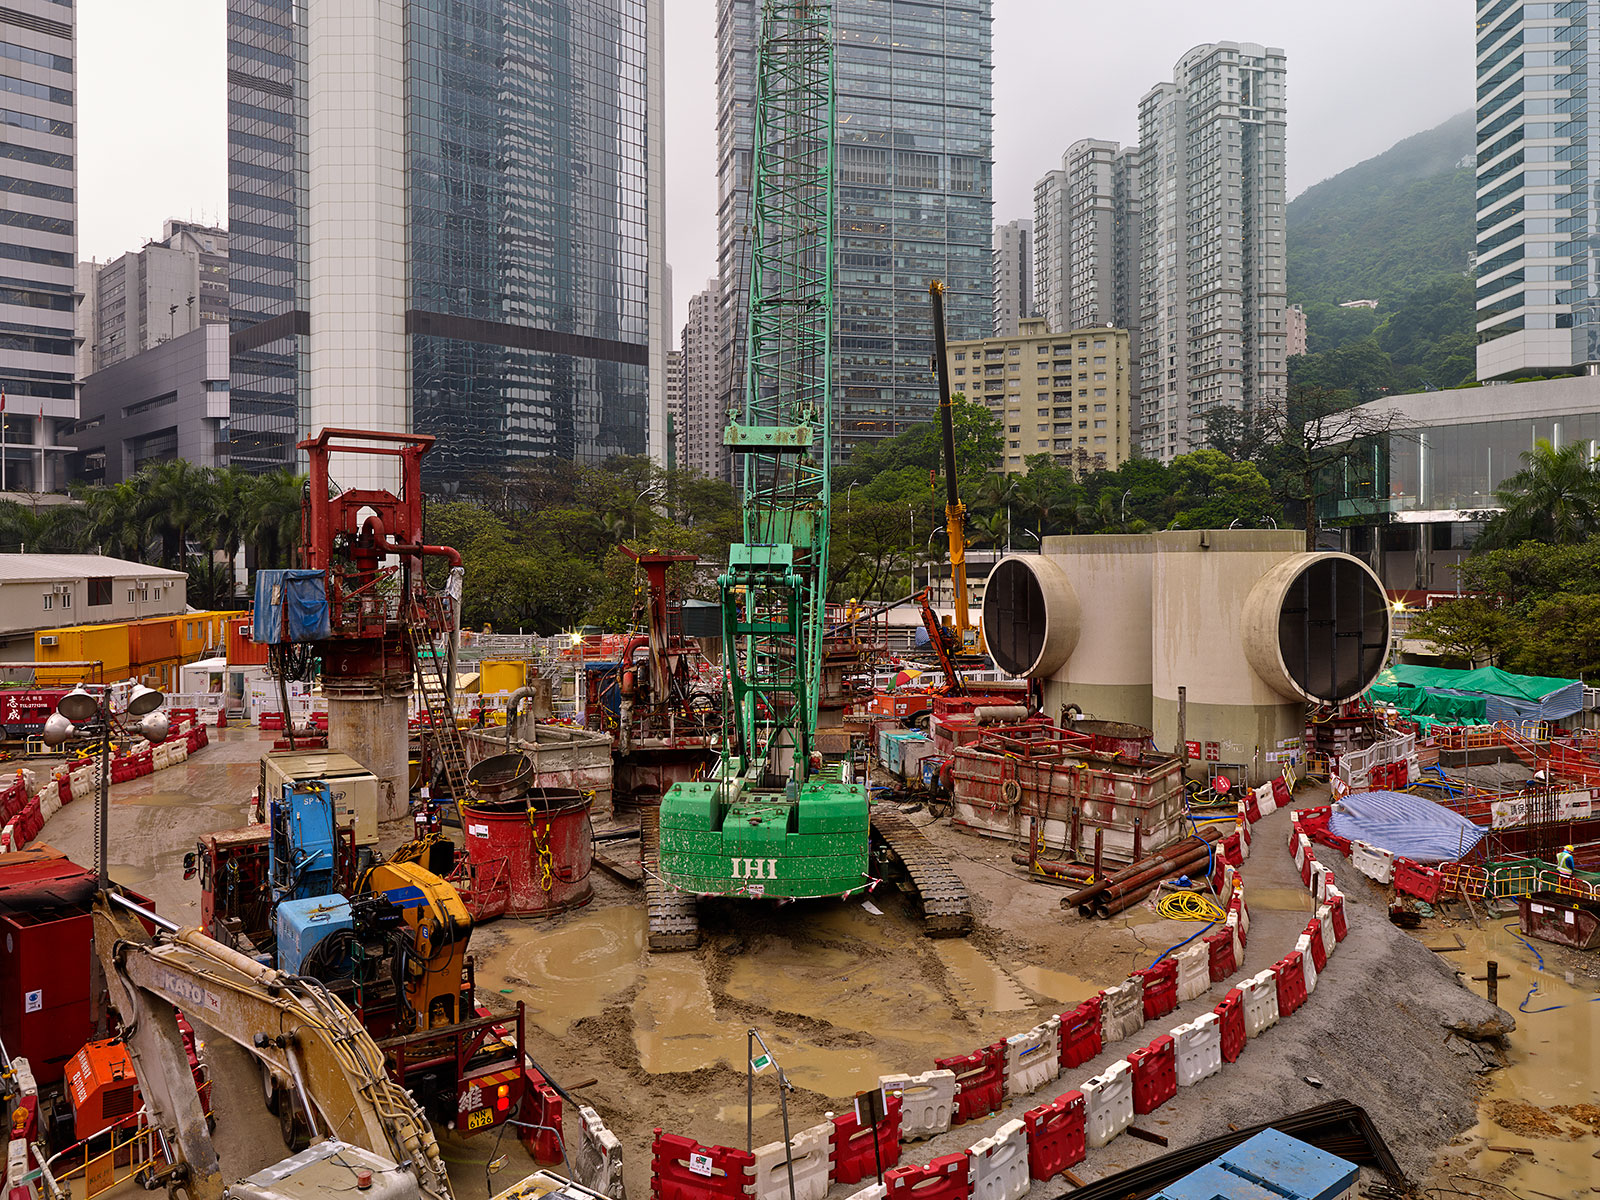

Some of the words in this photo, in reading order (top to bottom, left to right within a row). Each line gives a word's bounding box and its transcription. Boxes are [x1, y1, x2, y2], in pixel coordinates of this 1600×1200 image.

[341, 659, 348, 672] 6
[6, 695, 20, 720] 志成
[730, 857, 778, 880] IHI
[165, 972, 203, 1004] KATO
[470, 1116, 491, 1128] 6126
[474, 1110, 487, 1120] NN
